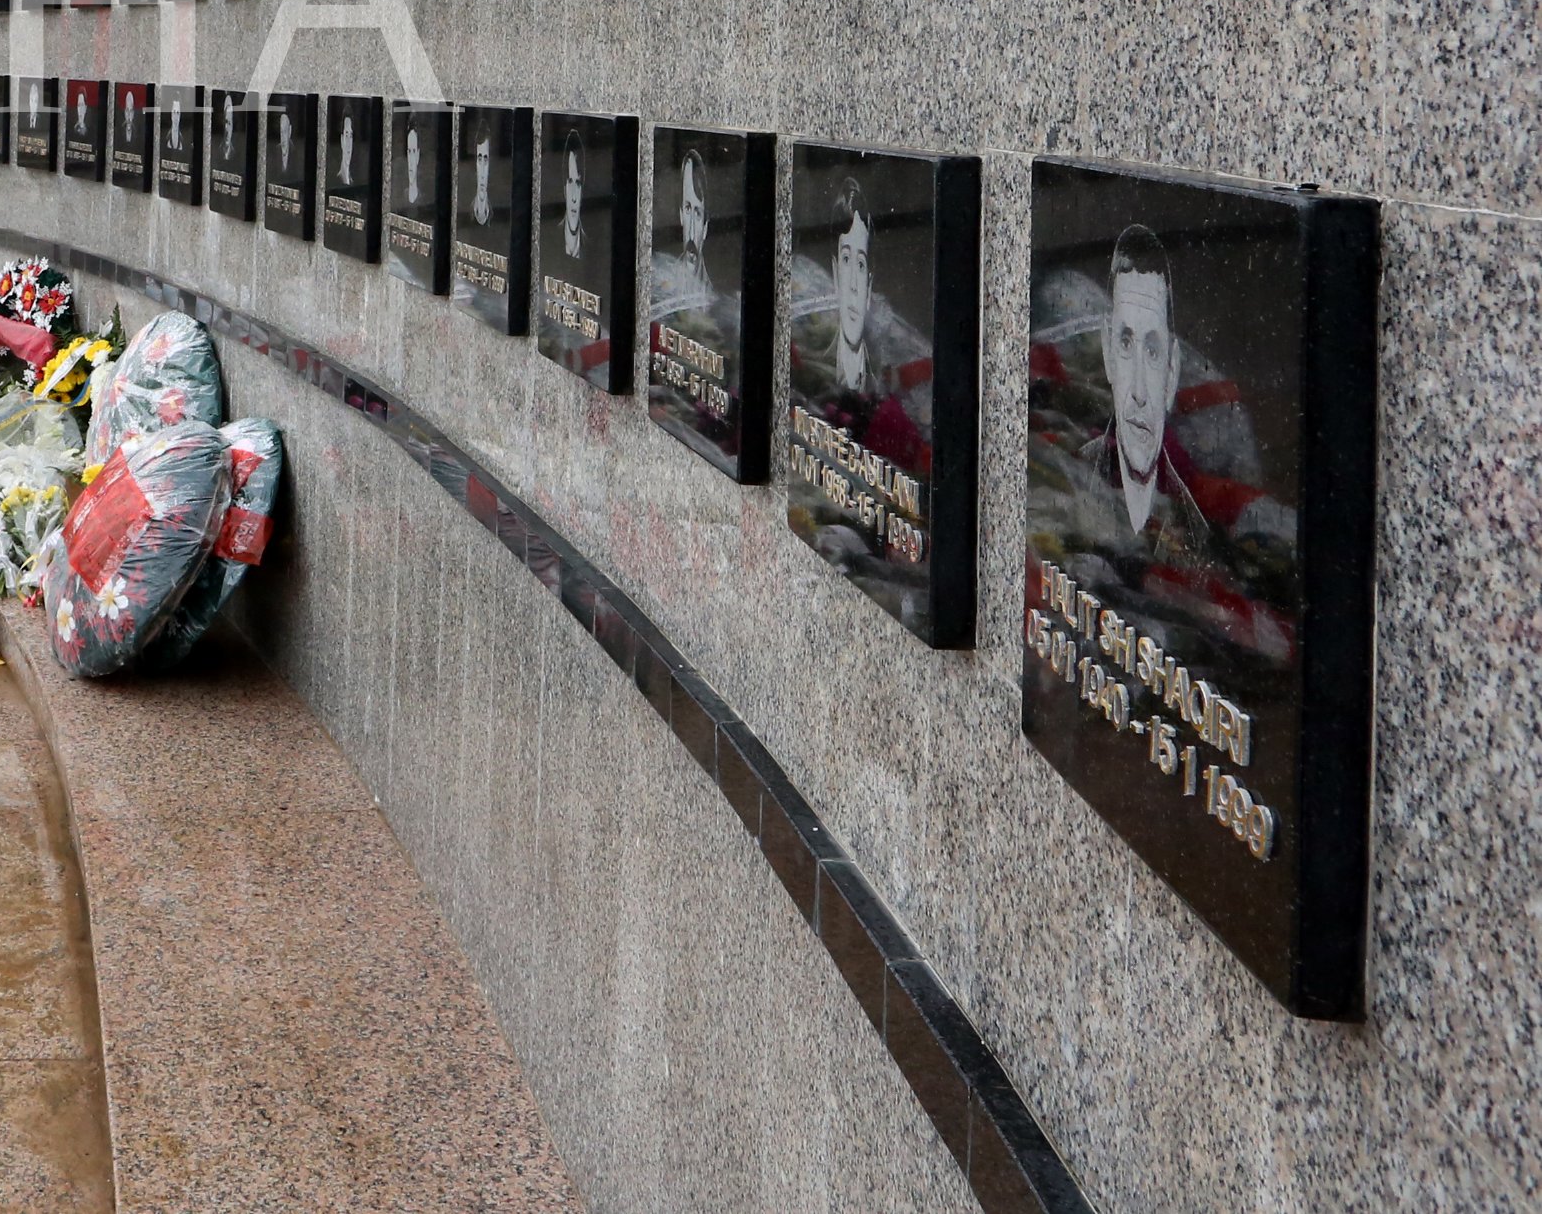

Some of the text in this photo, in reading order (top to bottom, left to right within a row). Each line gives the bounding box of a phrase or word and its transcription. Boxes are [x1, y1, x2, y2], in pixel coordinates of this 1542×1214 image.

[1078, 656, 1130, 732] 1940
[1147, 715, 1178, 776] 15
[1180, 746, 1196, 796] 1
[1203, 765, 1274, 861] 1999
[1099, 609, 1136, 674] SH
[1137, 636, 1250, 767] SHAQIRI
